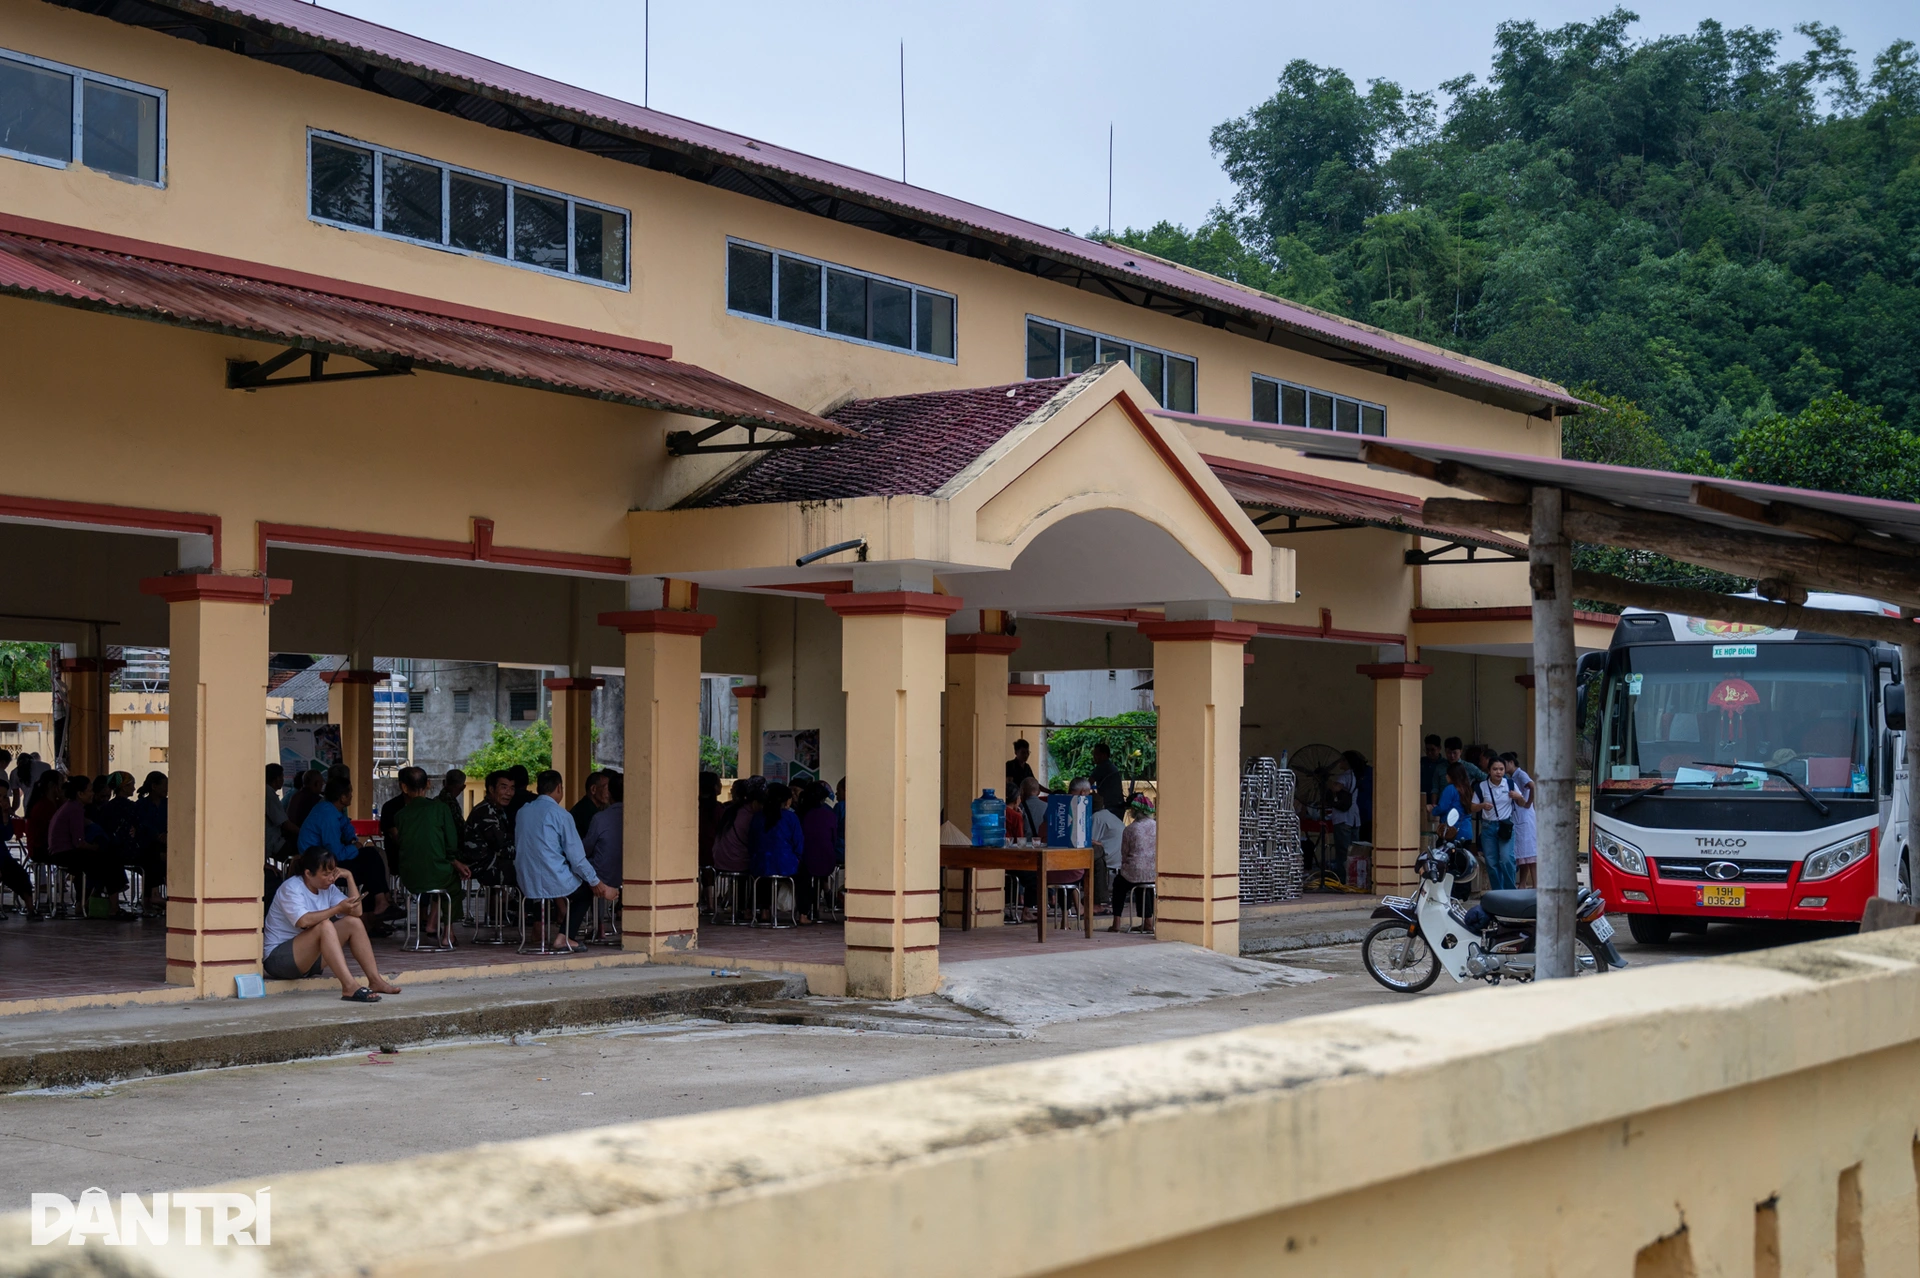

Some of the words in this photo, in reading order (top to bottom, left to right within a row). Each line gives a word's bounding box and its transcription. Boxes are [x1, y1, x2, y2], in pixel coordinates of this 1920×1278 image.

[1714, 648, 1723, 656] XE
[1057, 802, 1067, 838] AQUAFINA
[1695, 837, 1747, 848] THACO
[1716, 887, 1733, 896] 19H
[1707, 896, 1741, 906] 036.28
